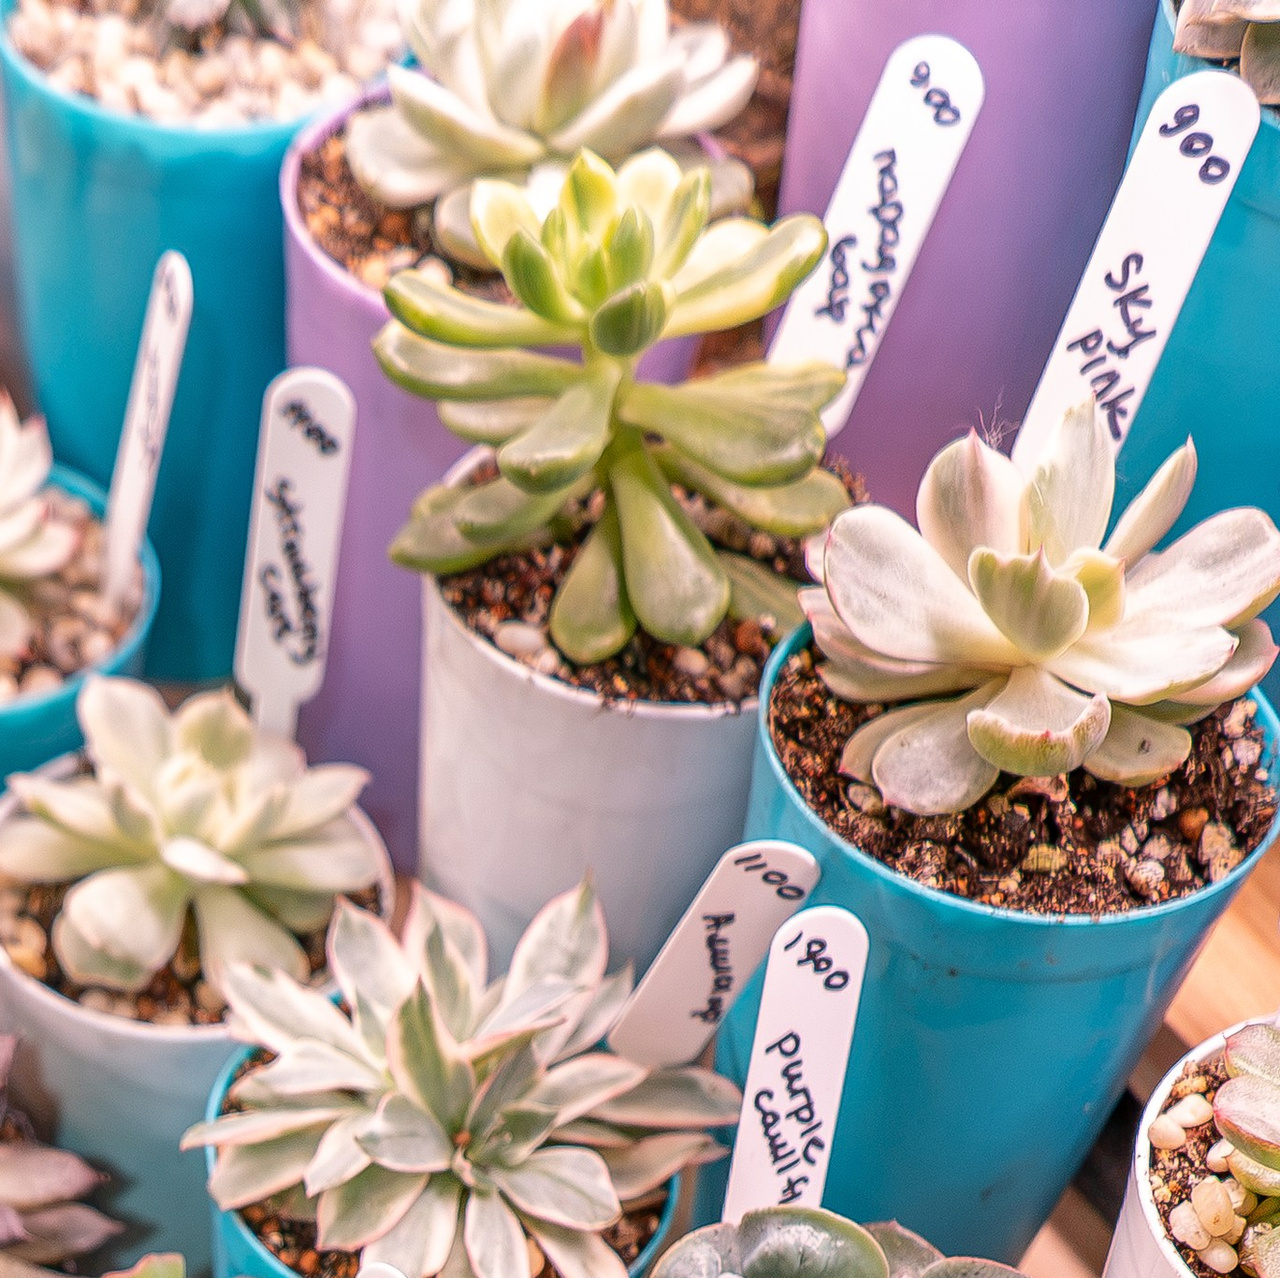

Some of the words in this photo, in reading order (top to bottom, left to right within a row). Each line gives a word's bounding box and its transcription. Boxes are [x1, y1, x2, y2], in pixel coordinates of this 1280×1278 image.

[1159, 104, 1231, 186] 900
[734, 854, 805, 900] 1100
[765, 1032, 824, 1165] purple
